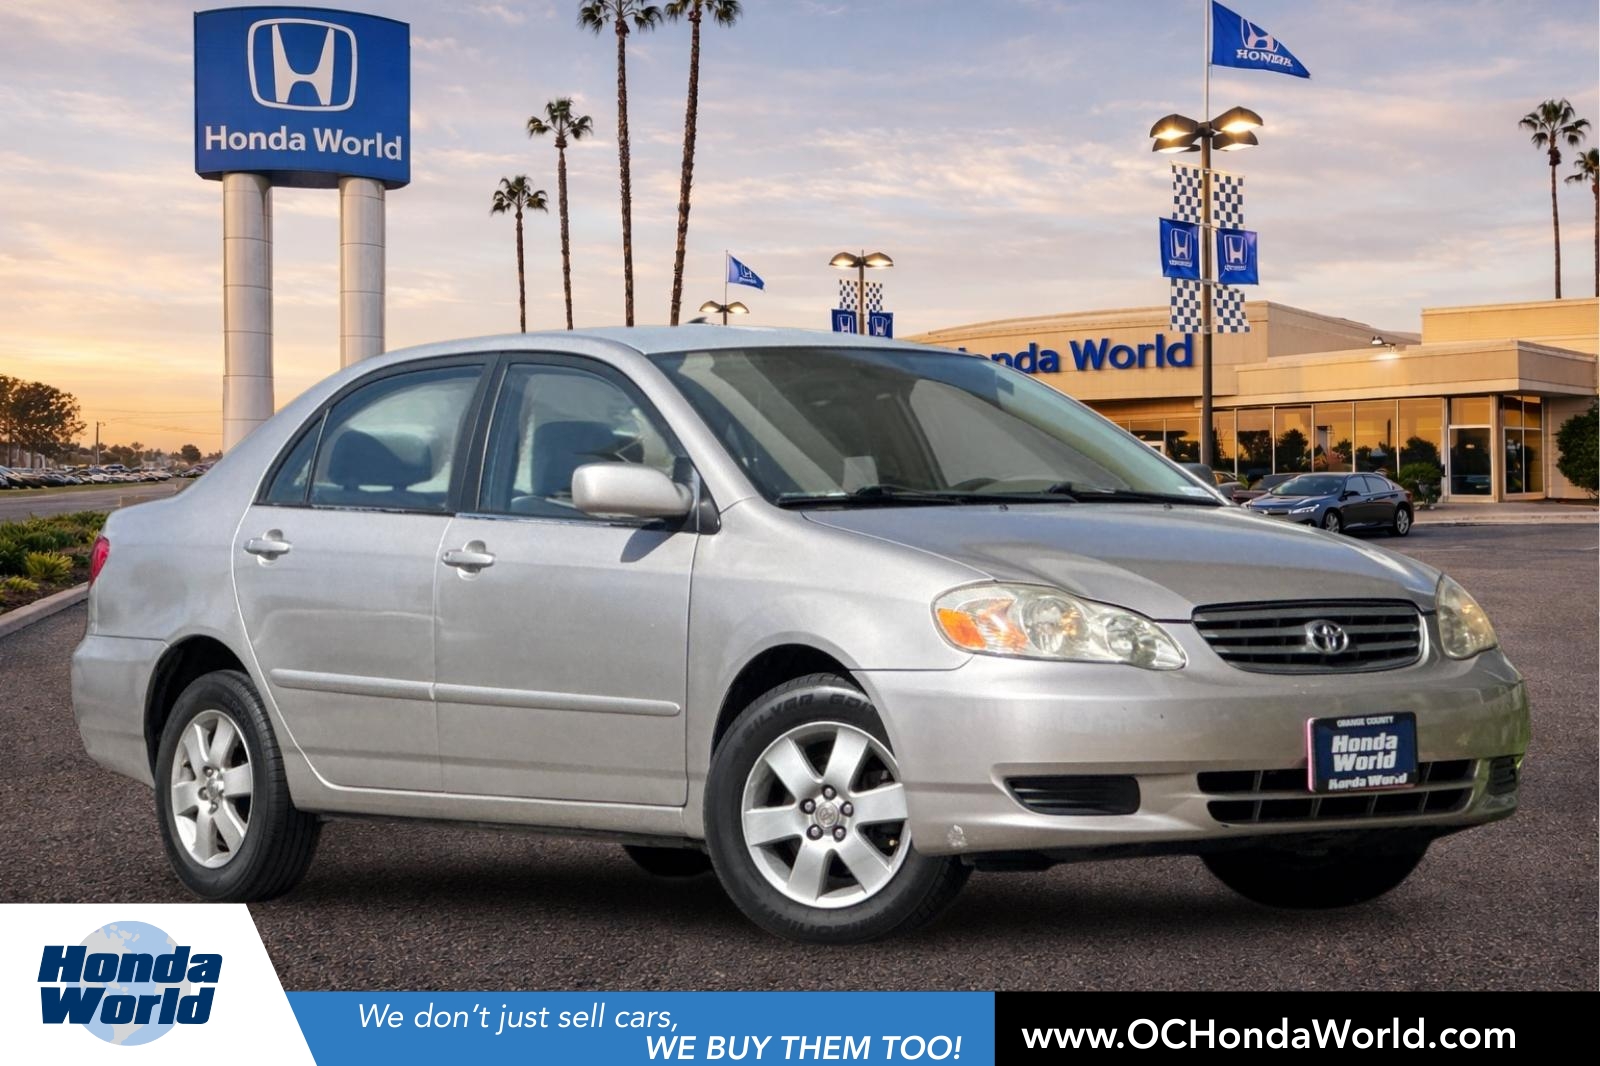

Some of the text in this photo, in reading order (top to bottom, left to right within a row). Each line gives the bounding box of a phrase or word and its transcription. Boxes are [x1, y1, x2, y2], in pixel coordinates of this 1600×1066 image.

[205, 125, 402, 160] Honda World
[958, 333, 1194, 374] nda World
[1366, 715, 1394, 725] COUNTY
[1331, 732, 1398, 753] Honda
[1333, 750, 1396, 772] World
